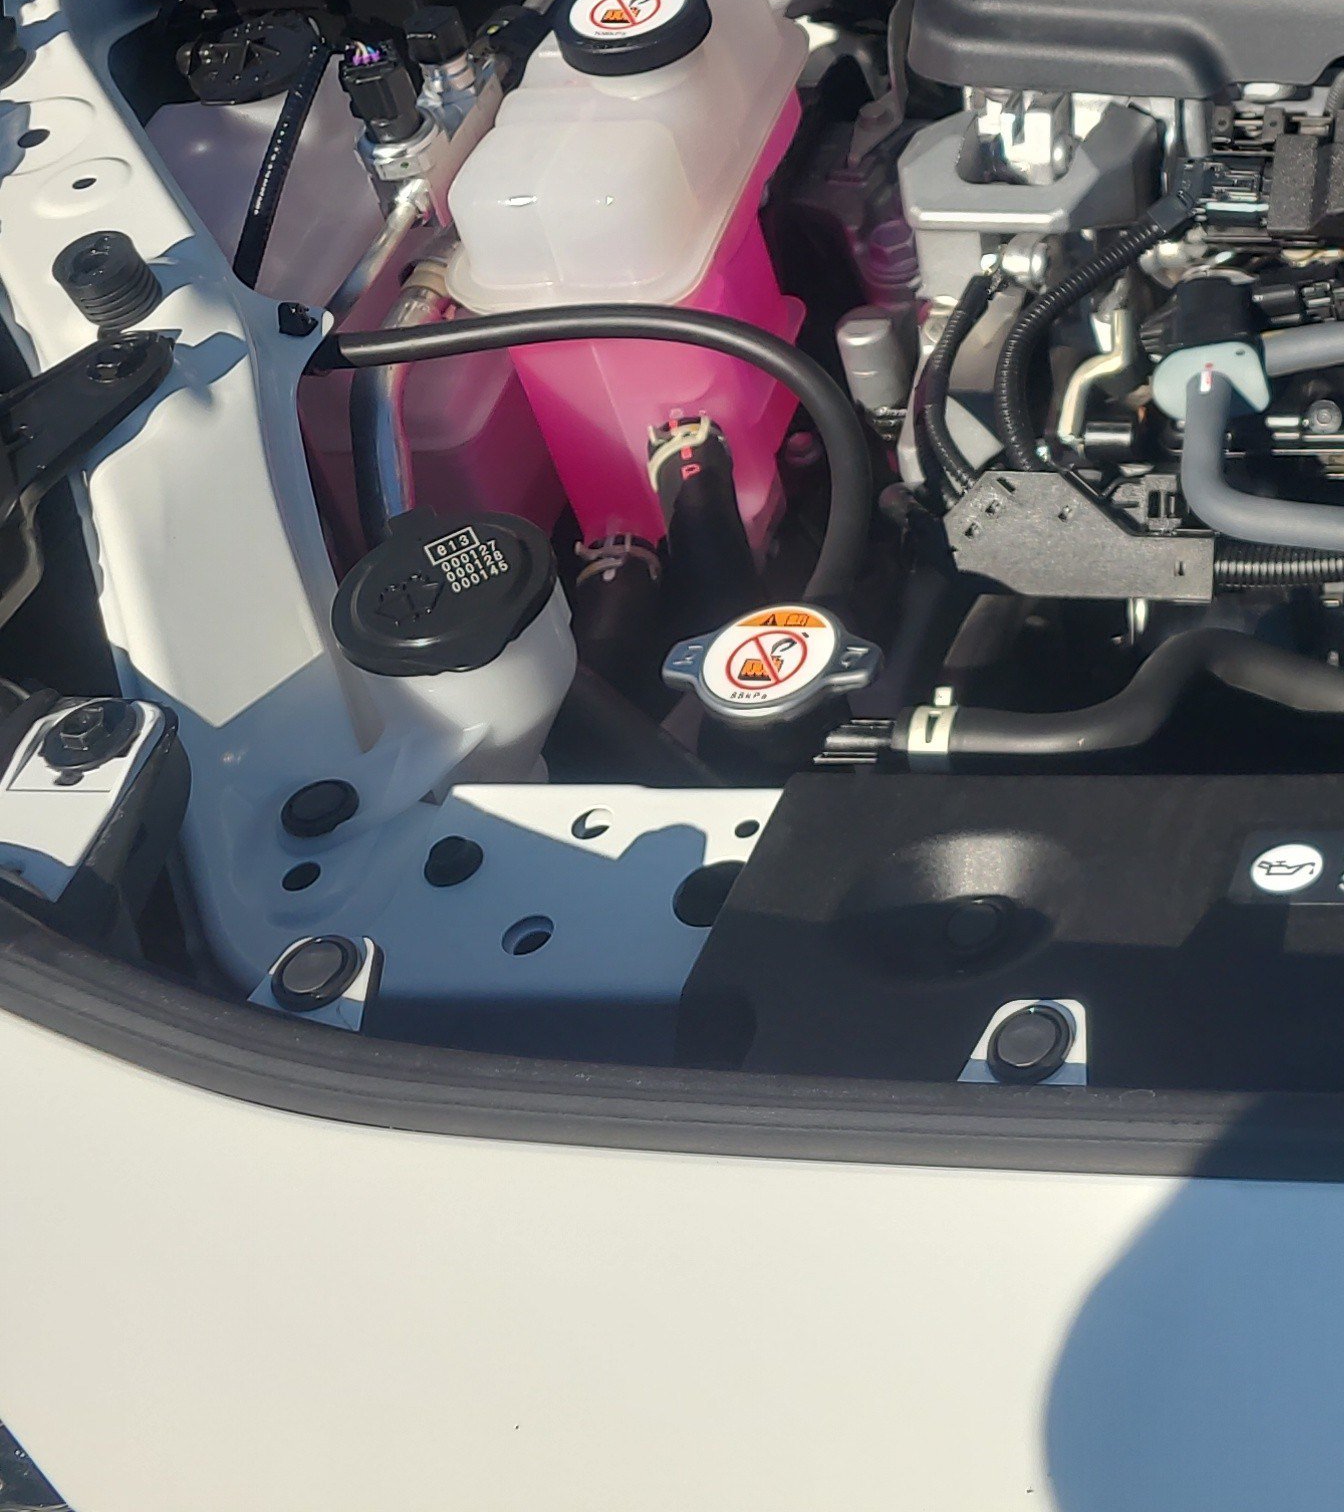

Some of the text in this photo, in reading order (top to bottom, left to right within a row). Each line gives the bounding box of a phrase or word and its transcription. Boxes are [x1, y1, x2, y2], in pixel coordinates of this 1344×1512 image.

[436, 534, 470, 557] e13
[441, 539, 497, 572] 000127
[446, 549, 504, 582] 000128
[451, 559, 509, 593] 000145
